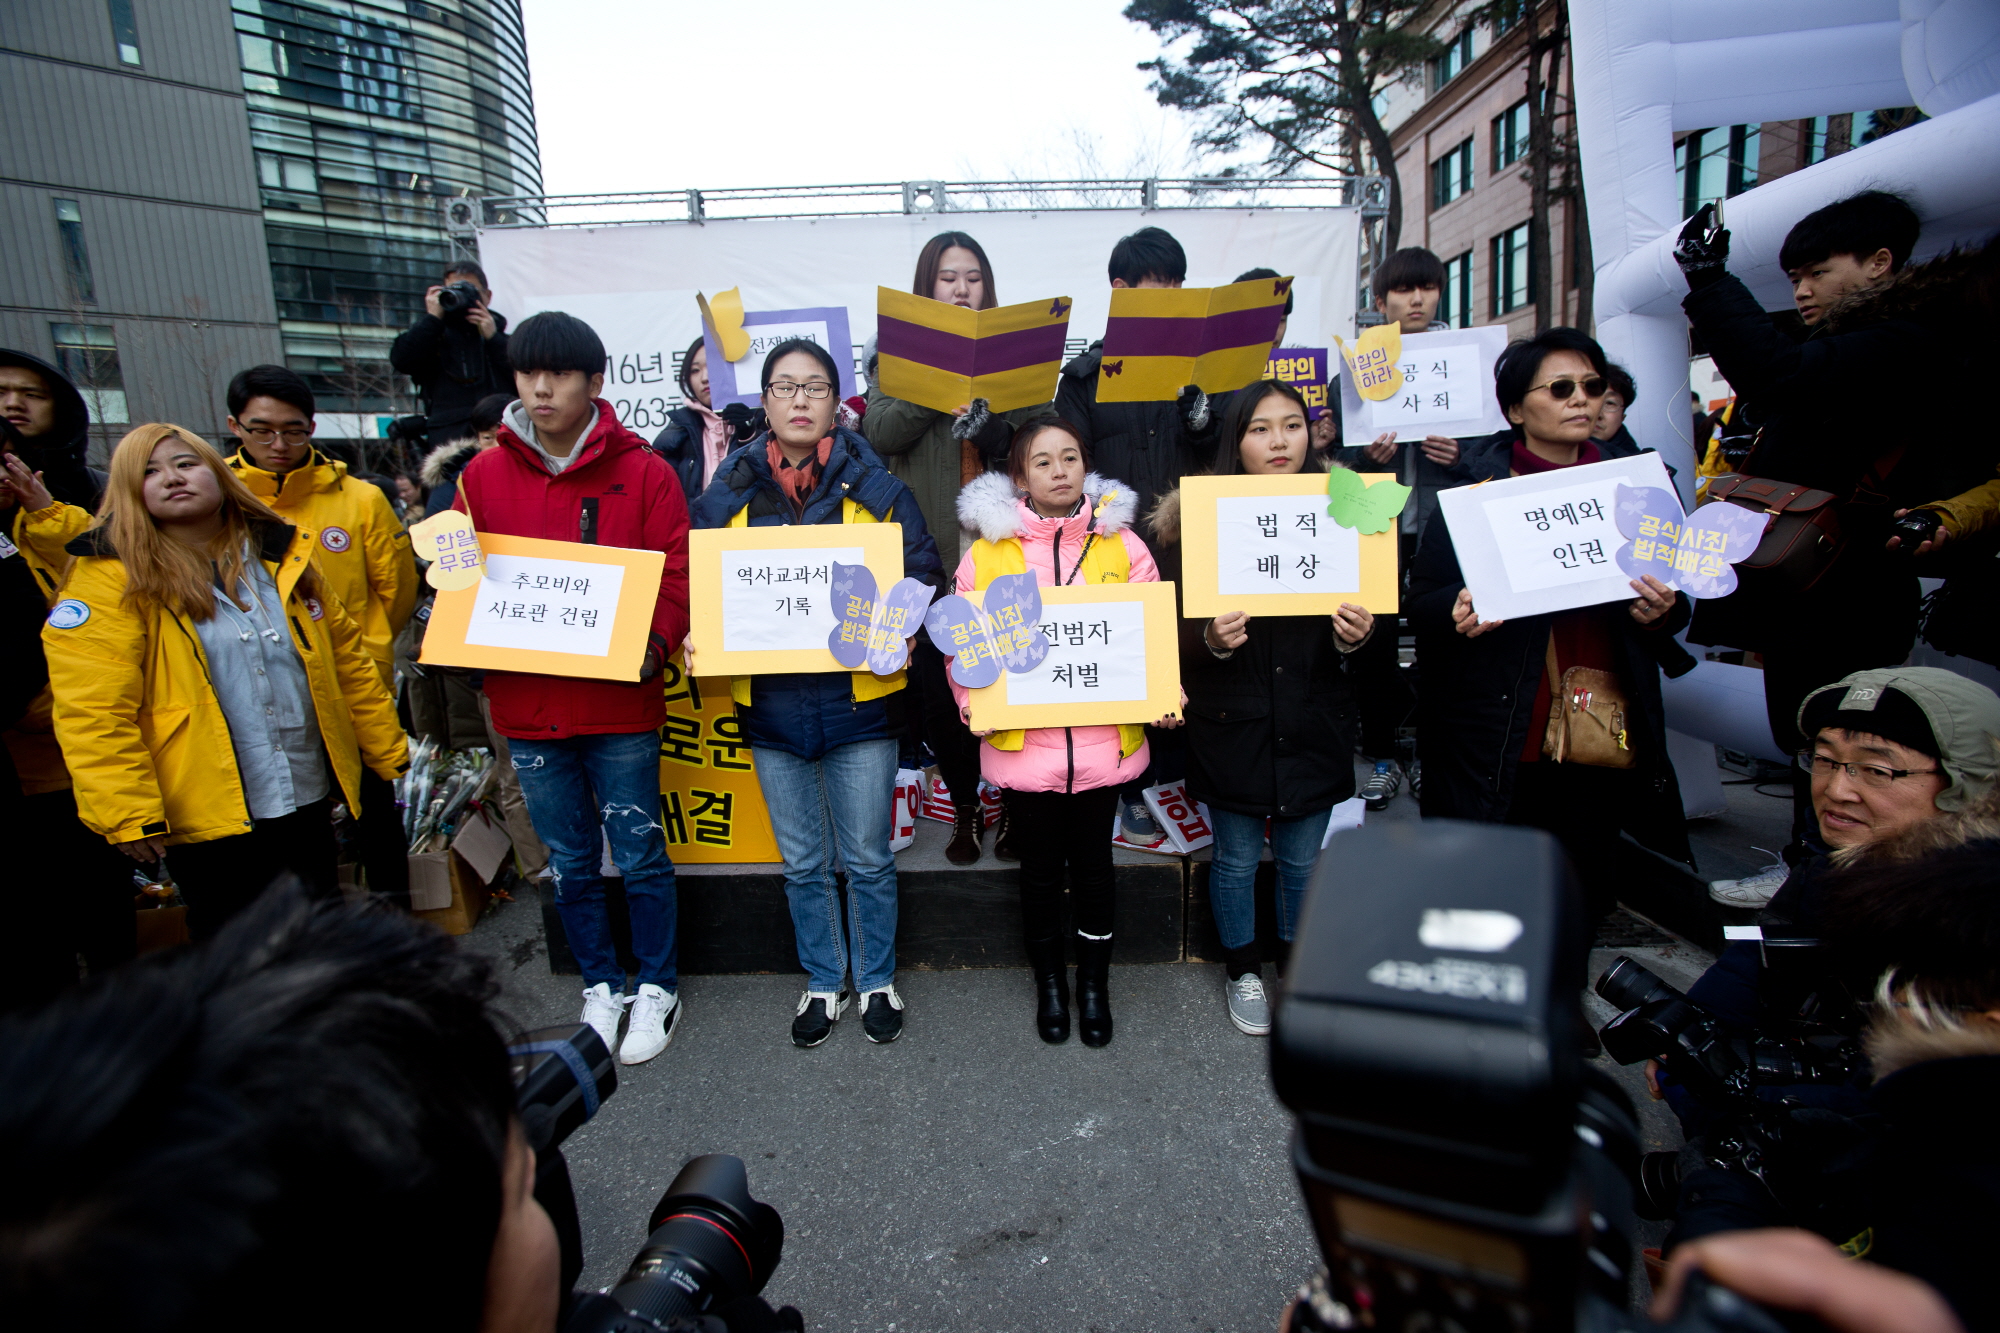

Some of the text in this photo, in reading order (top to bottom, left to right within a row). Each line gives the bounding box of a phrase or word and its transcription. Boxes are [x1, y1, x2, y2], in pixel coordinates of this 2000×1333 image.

[1524, 498, 1604, 531] 명예와
[436, 527, 479, 552] 한일
[1553, 539, 1607, 568] 인권
[511, 572, 591, 596] 추모비와
[488, 600, 598, 627] 사료관 건립
[775, 597, 812, 616] 기록
[1037, 619, 1112, 648] 전범자
[1052, 662, 1099, 688] 처벌
